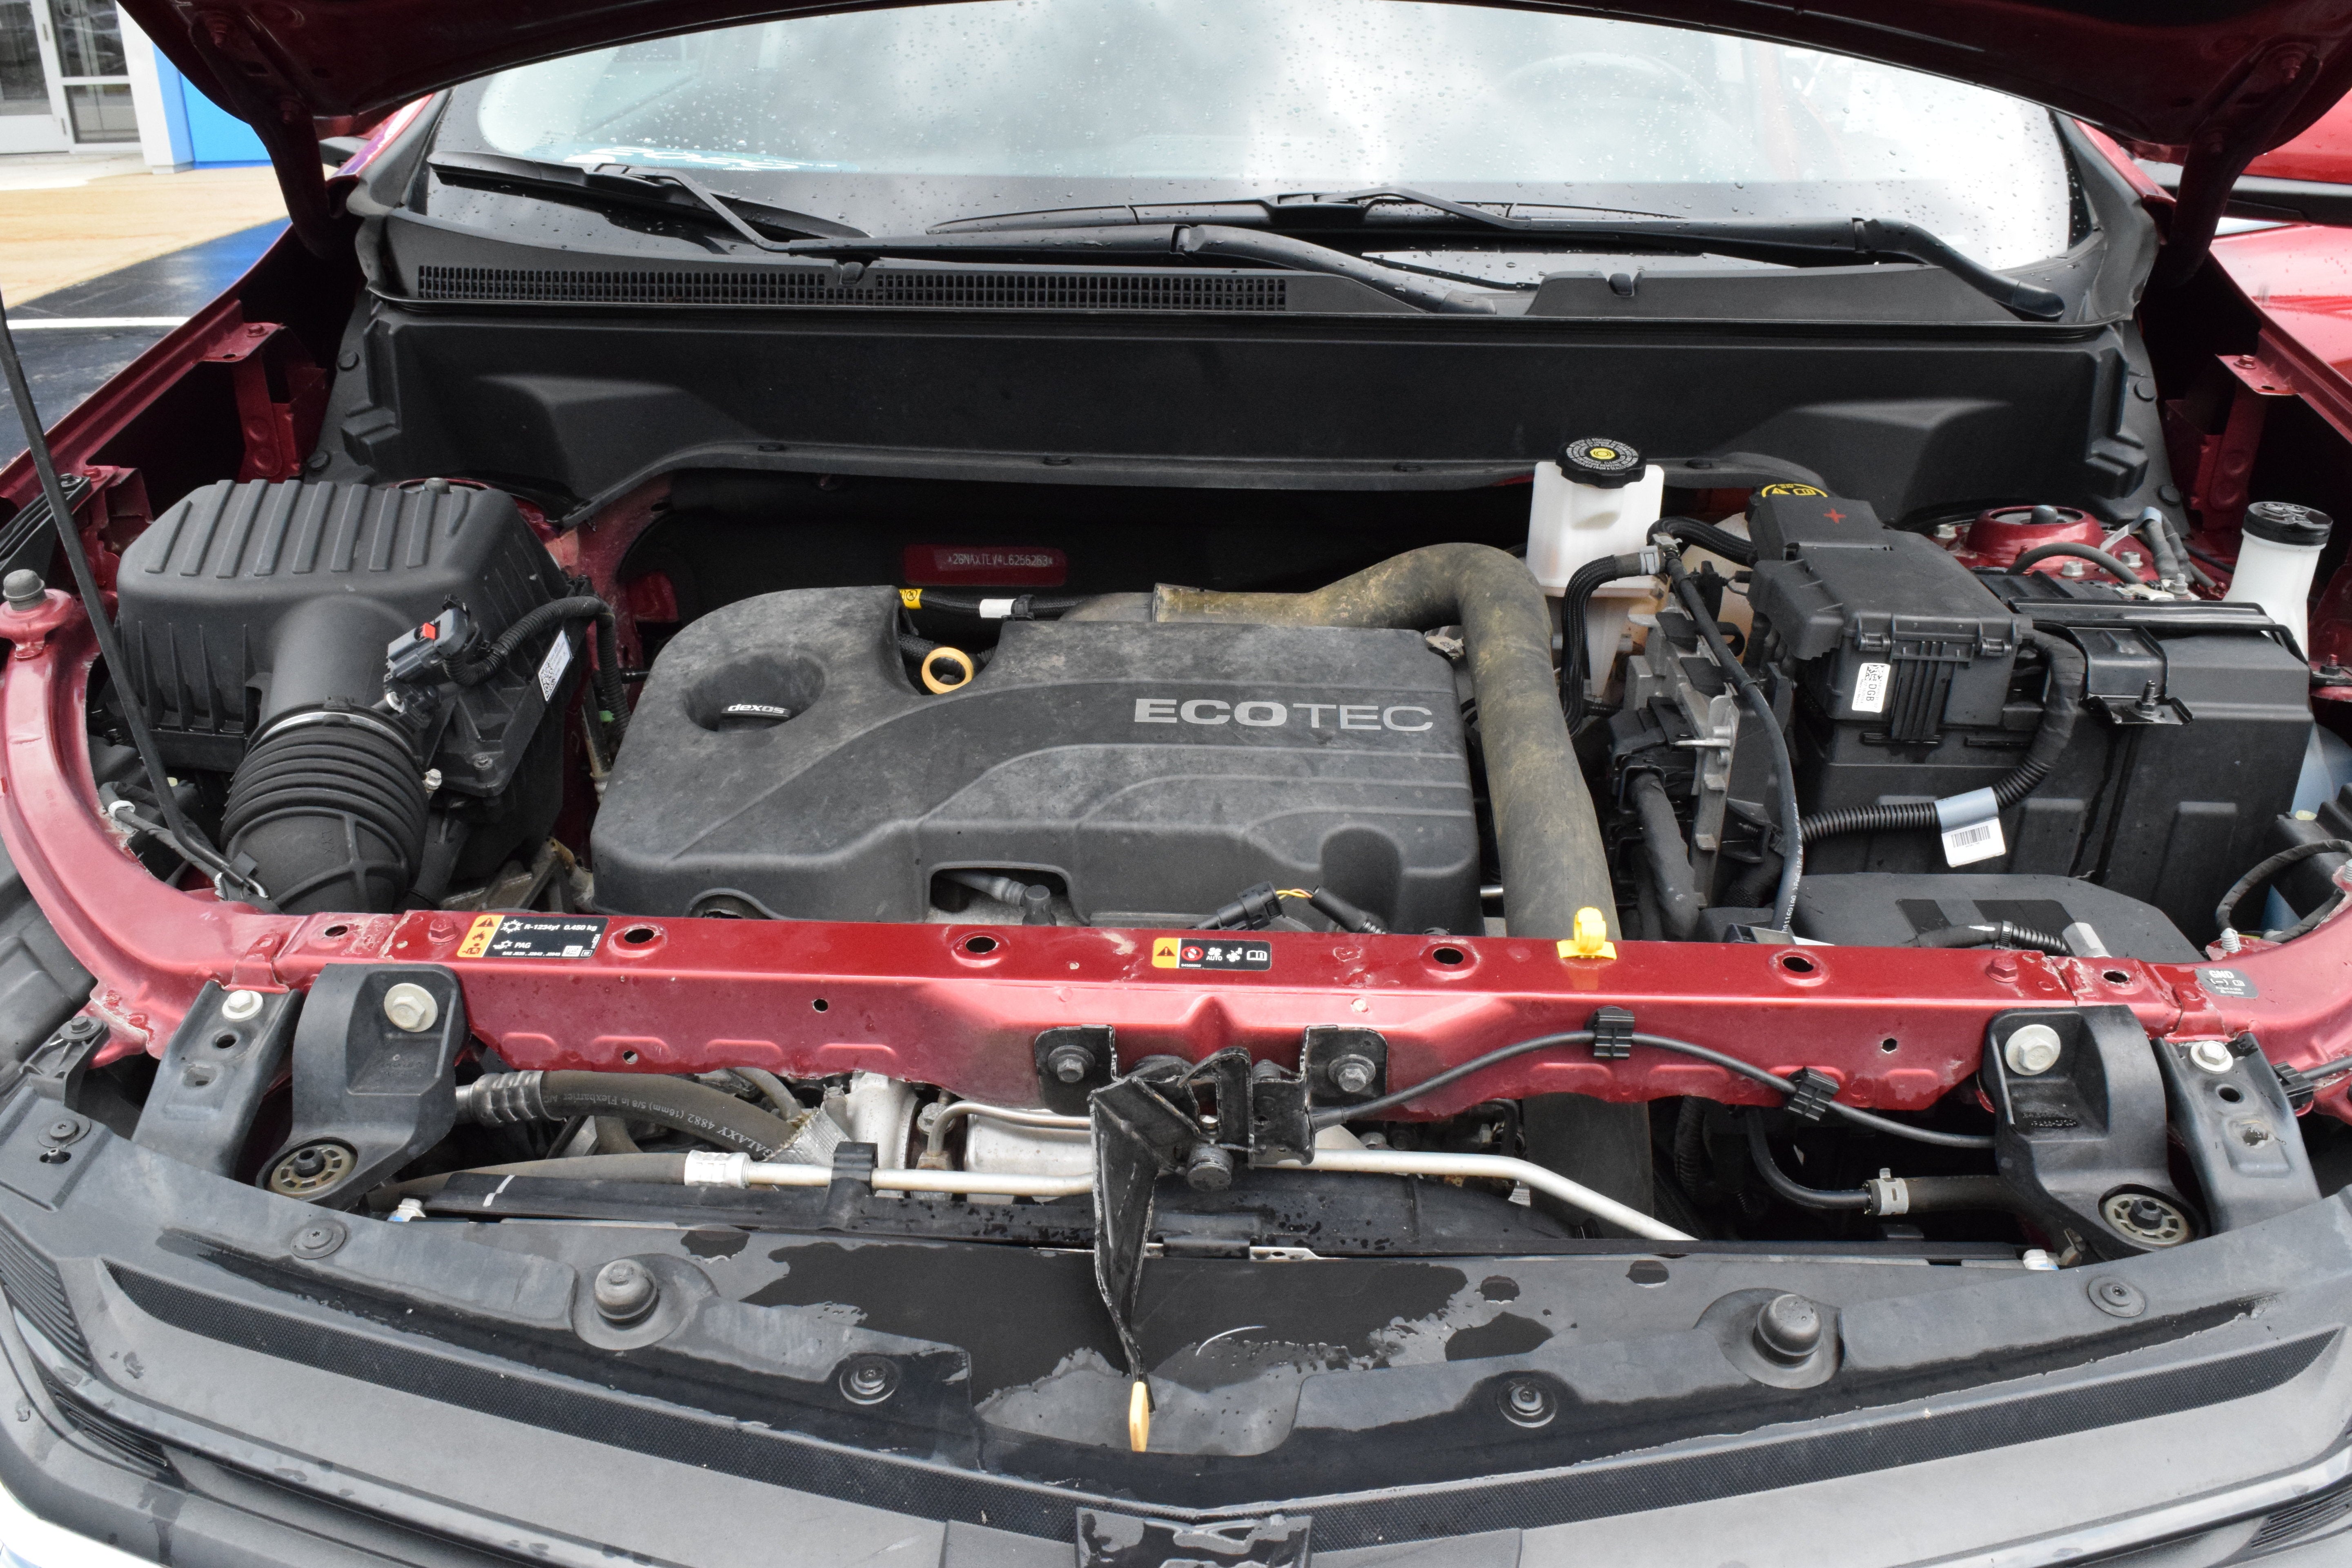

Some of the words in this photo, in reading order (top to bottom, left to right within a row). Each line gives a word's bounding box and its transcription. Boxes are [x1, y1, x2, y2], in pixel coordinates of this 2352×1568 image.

[1866, 684, 1877, 701] DGB
[728, 704, 787, 714] dexos
[1134, 699, 1433, 732] ECOTEC
[2209, 970, 2235, 979] GND
[563, 1093, 618, 1105] Flexbarrier
[632, 1100, 646, 1109] 5/8
[688, 1113, 715, 1129] 4882
[717, 1126, 774, 1158] GALAXY
